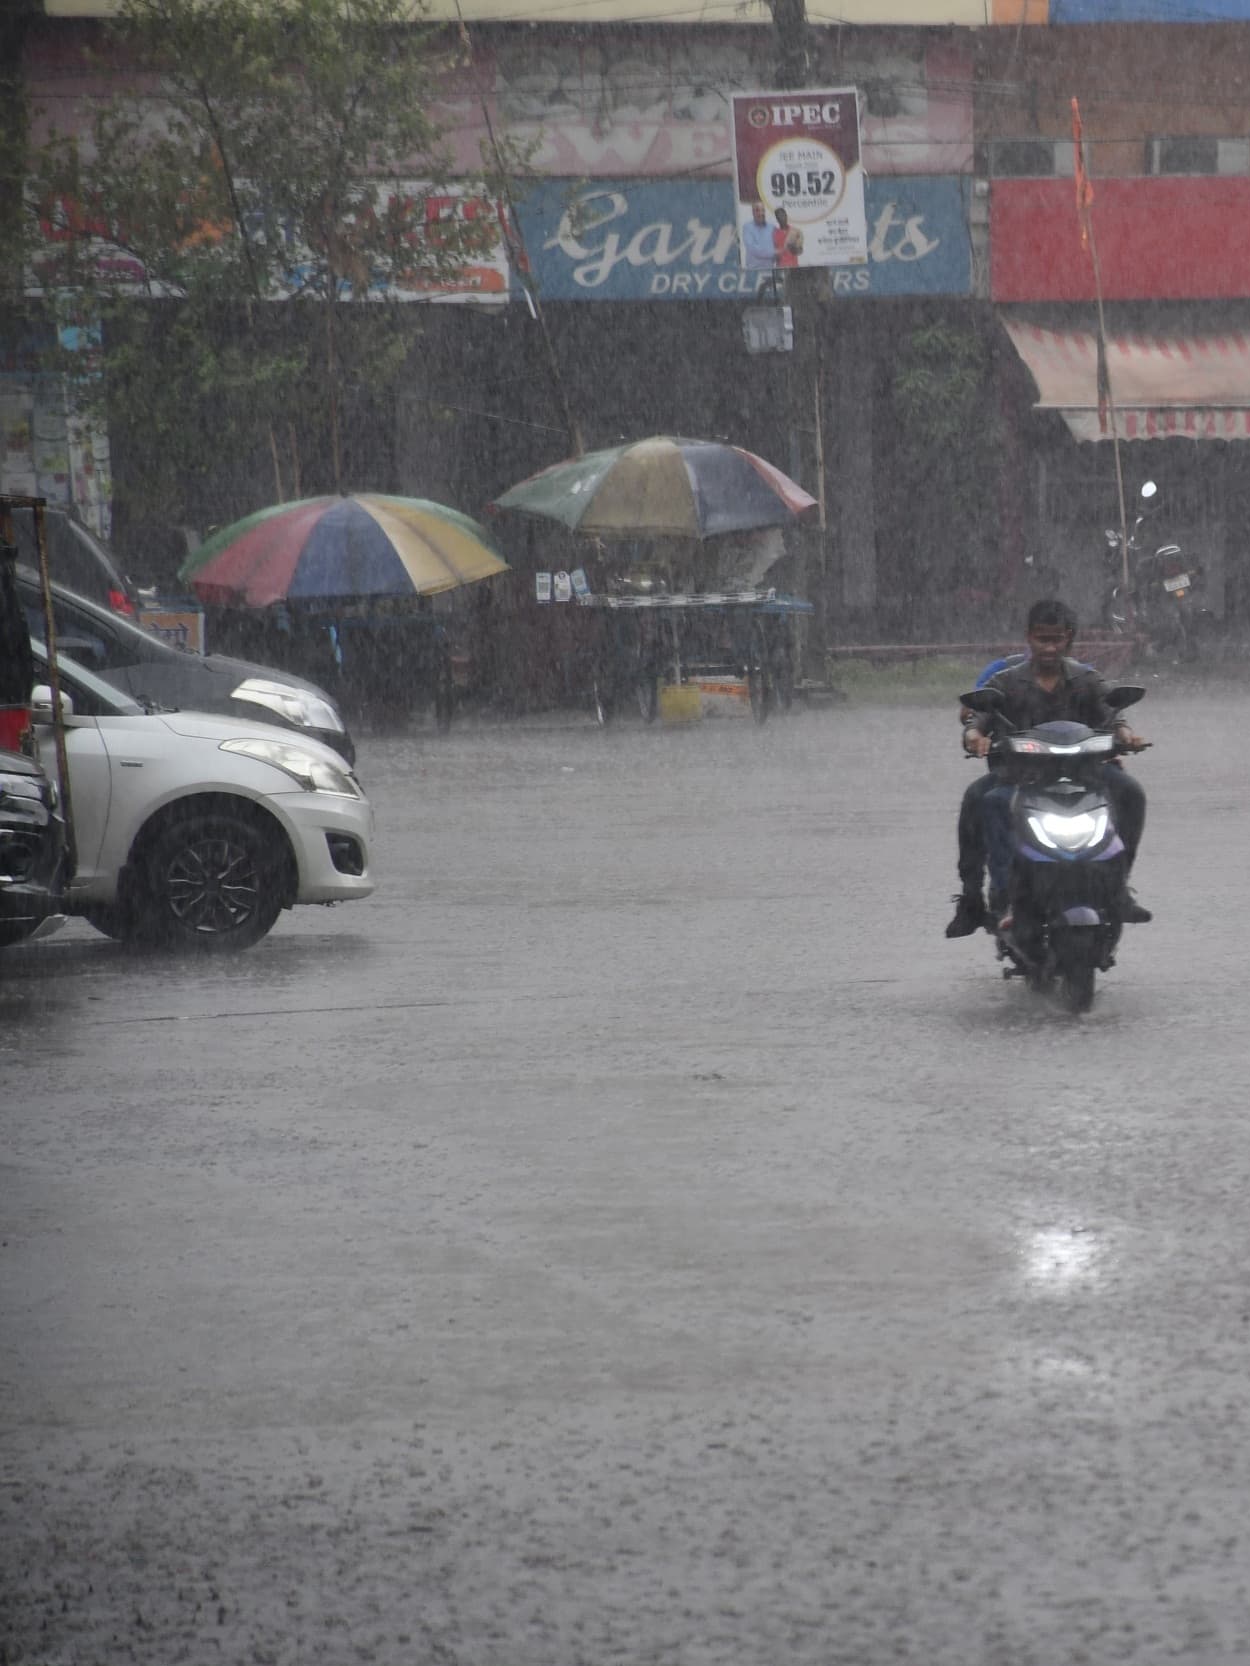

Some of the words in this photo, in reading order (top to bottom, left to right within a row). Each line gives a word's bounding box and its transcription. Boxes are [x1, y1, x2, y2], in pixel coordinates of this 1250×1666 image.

[771, 102, 841, 127] IPEC
[771, 170, 836, 197] 99.52
[651, 273, 711, 294] DRY
